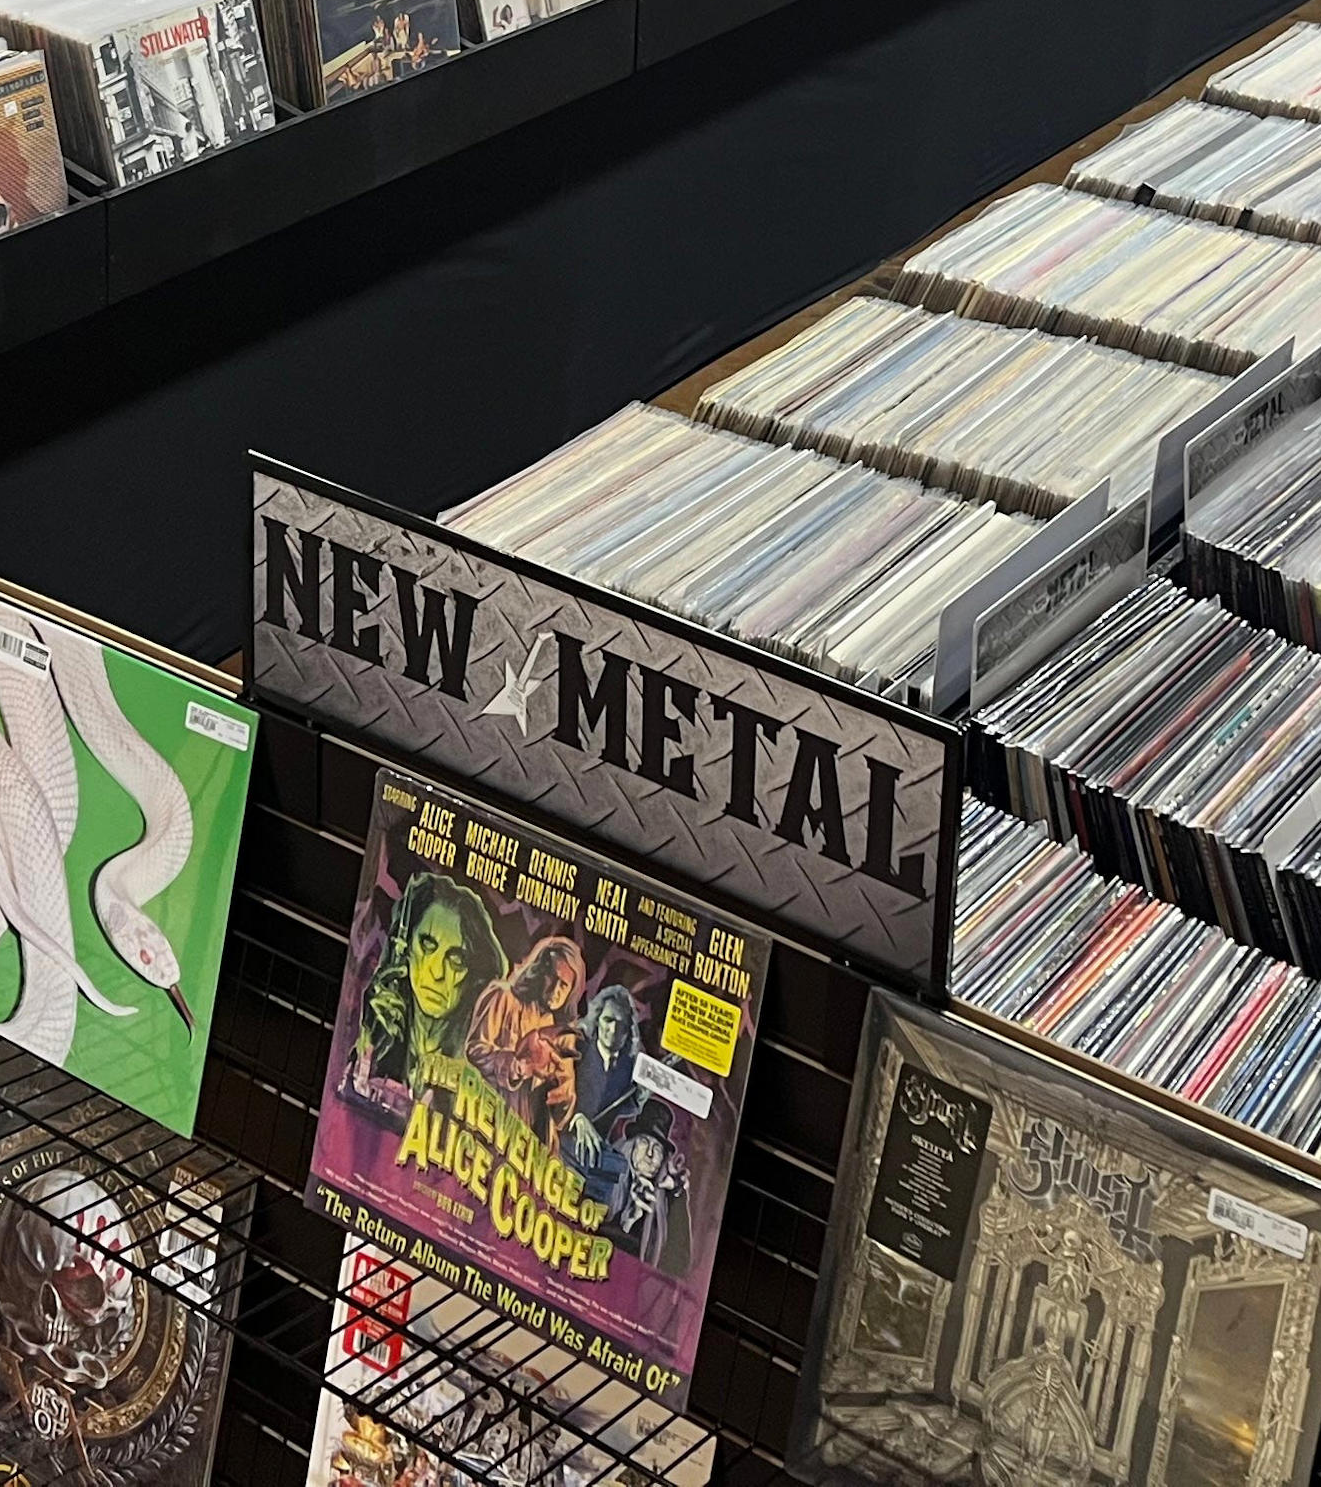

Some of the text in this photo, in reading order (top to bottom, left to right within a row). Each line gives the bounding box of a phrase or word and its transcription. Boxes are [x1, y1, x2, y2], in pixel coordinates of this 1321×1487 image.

[140, 16, 211, 58] STILLWATER
[258, 513, 930, 903] NEW METAL
[408, 826, 457, 869] COOPER
[466, 854, 508, 893] BRUCE
[516, 874, 580, 923] DUNAWAY
[585, 908, 629, 946] SMITH
[693, 952, 750, 1000] BUXTON
[419, 802, 456, 838] ALICE
[465, 820, 520, 867] MICHAEL
[529, 848, 578, 891] DENNIS
[596, 878, 628, 914] NEAL
[709, 927, 745, 966] GLEN
[417, 1055, 466, 1090] THE
[456, 1067, 586, 1221] REVENGE
[581, 1199, 609, 1232] OF
[11, 1158, 29, 1179] OF
[396, 1100, 494, 1205] ALICE
[489, 1164, 614, 1281] COOPER
[355, 1209, 407, 1254] Return
[410, 1238, 461, 1285] Album
[464, 1265, 494, 1301] The
[497, 1284, 546, 1332] World
[549, 1313, 586, 1352] Was
[587, 1335, 642, 1385] Afraid
[30, 1382, 69, 1427] BEST
[33, 1409, 69, 1441] OF
